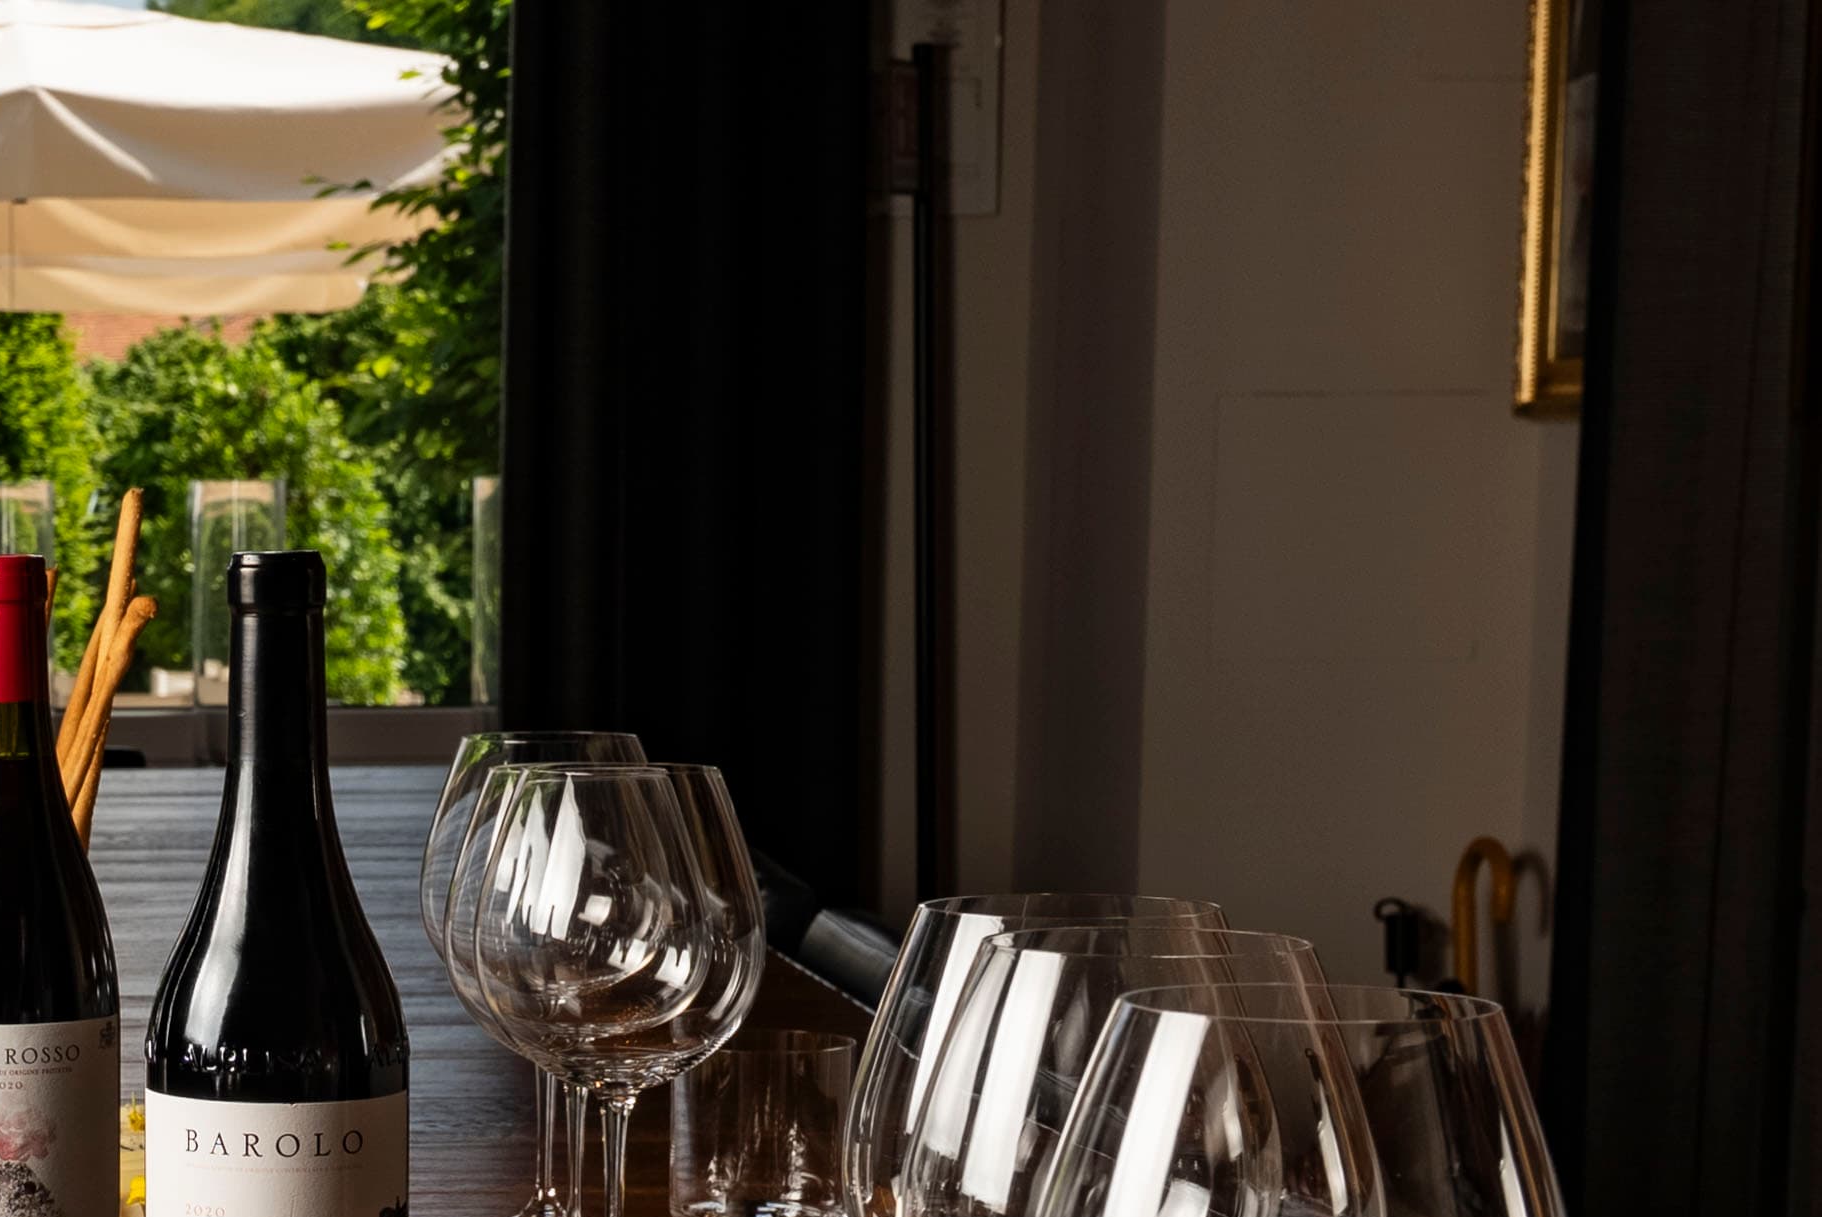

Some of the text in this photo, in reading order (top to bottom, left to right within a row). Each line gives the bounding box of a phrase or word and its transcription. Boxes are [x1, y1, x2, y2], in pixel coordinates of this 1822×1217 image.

[5, 1044, 80, 1065] ROSSO
[185, 1128, 364, 1158] BAROLO
[185, 1203, 226, 1217] 2020
